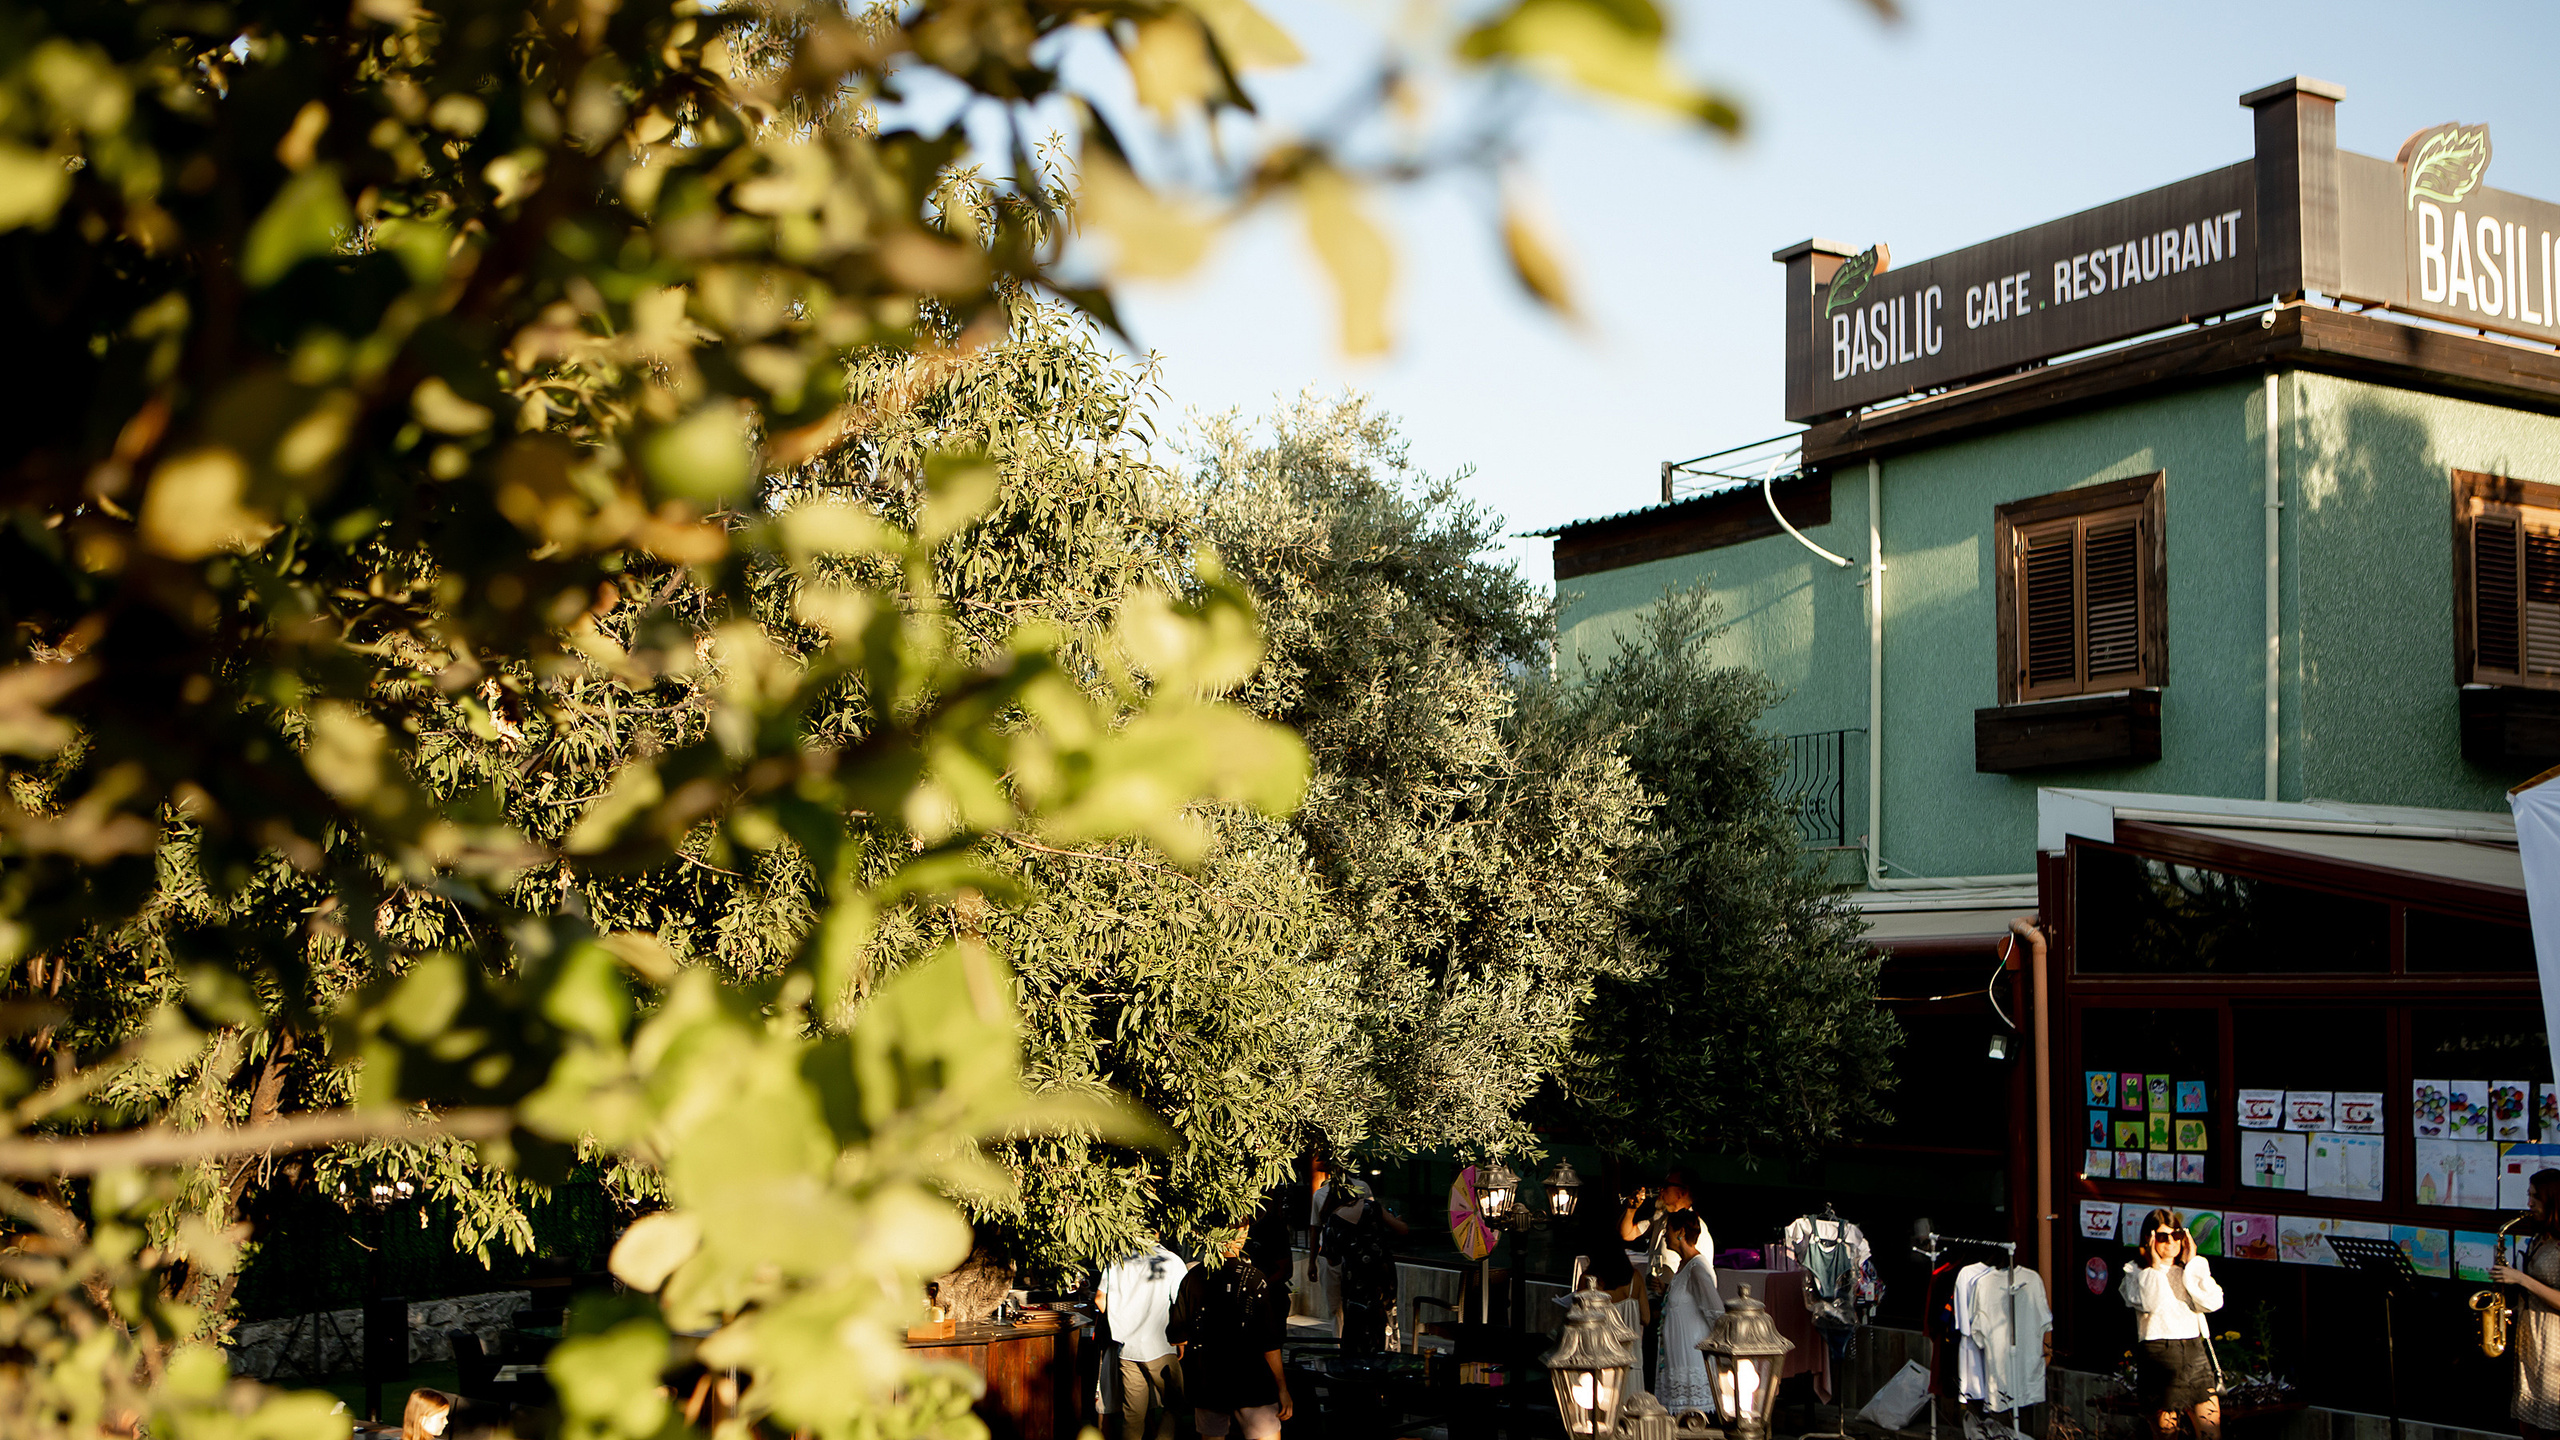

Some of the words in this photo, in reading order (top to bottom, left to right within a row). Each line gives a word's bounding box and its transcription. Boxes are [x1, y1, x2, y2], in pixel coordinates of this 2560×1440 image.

[1832, 284, 1943, 382] BASILIC
[1965, 270, 2031, 330] CAFE
[2053, 208, 2242, 306] RESTAURANT
[2418, 200, 2560, 328] BASILI
